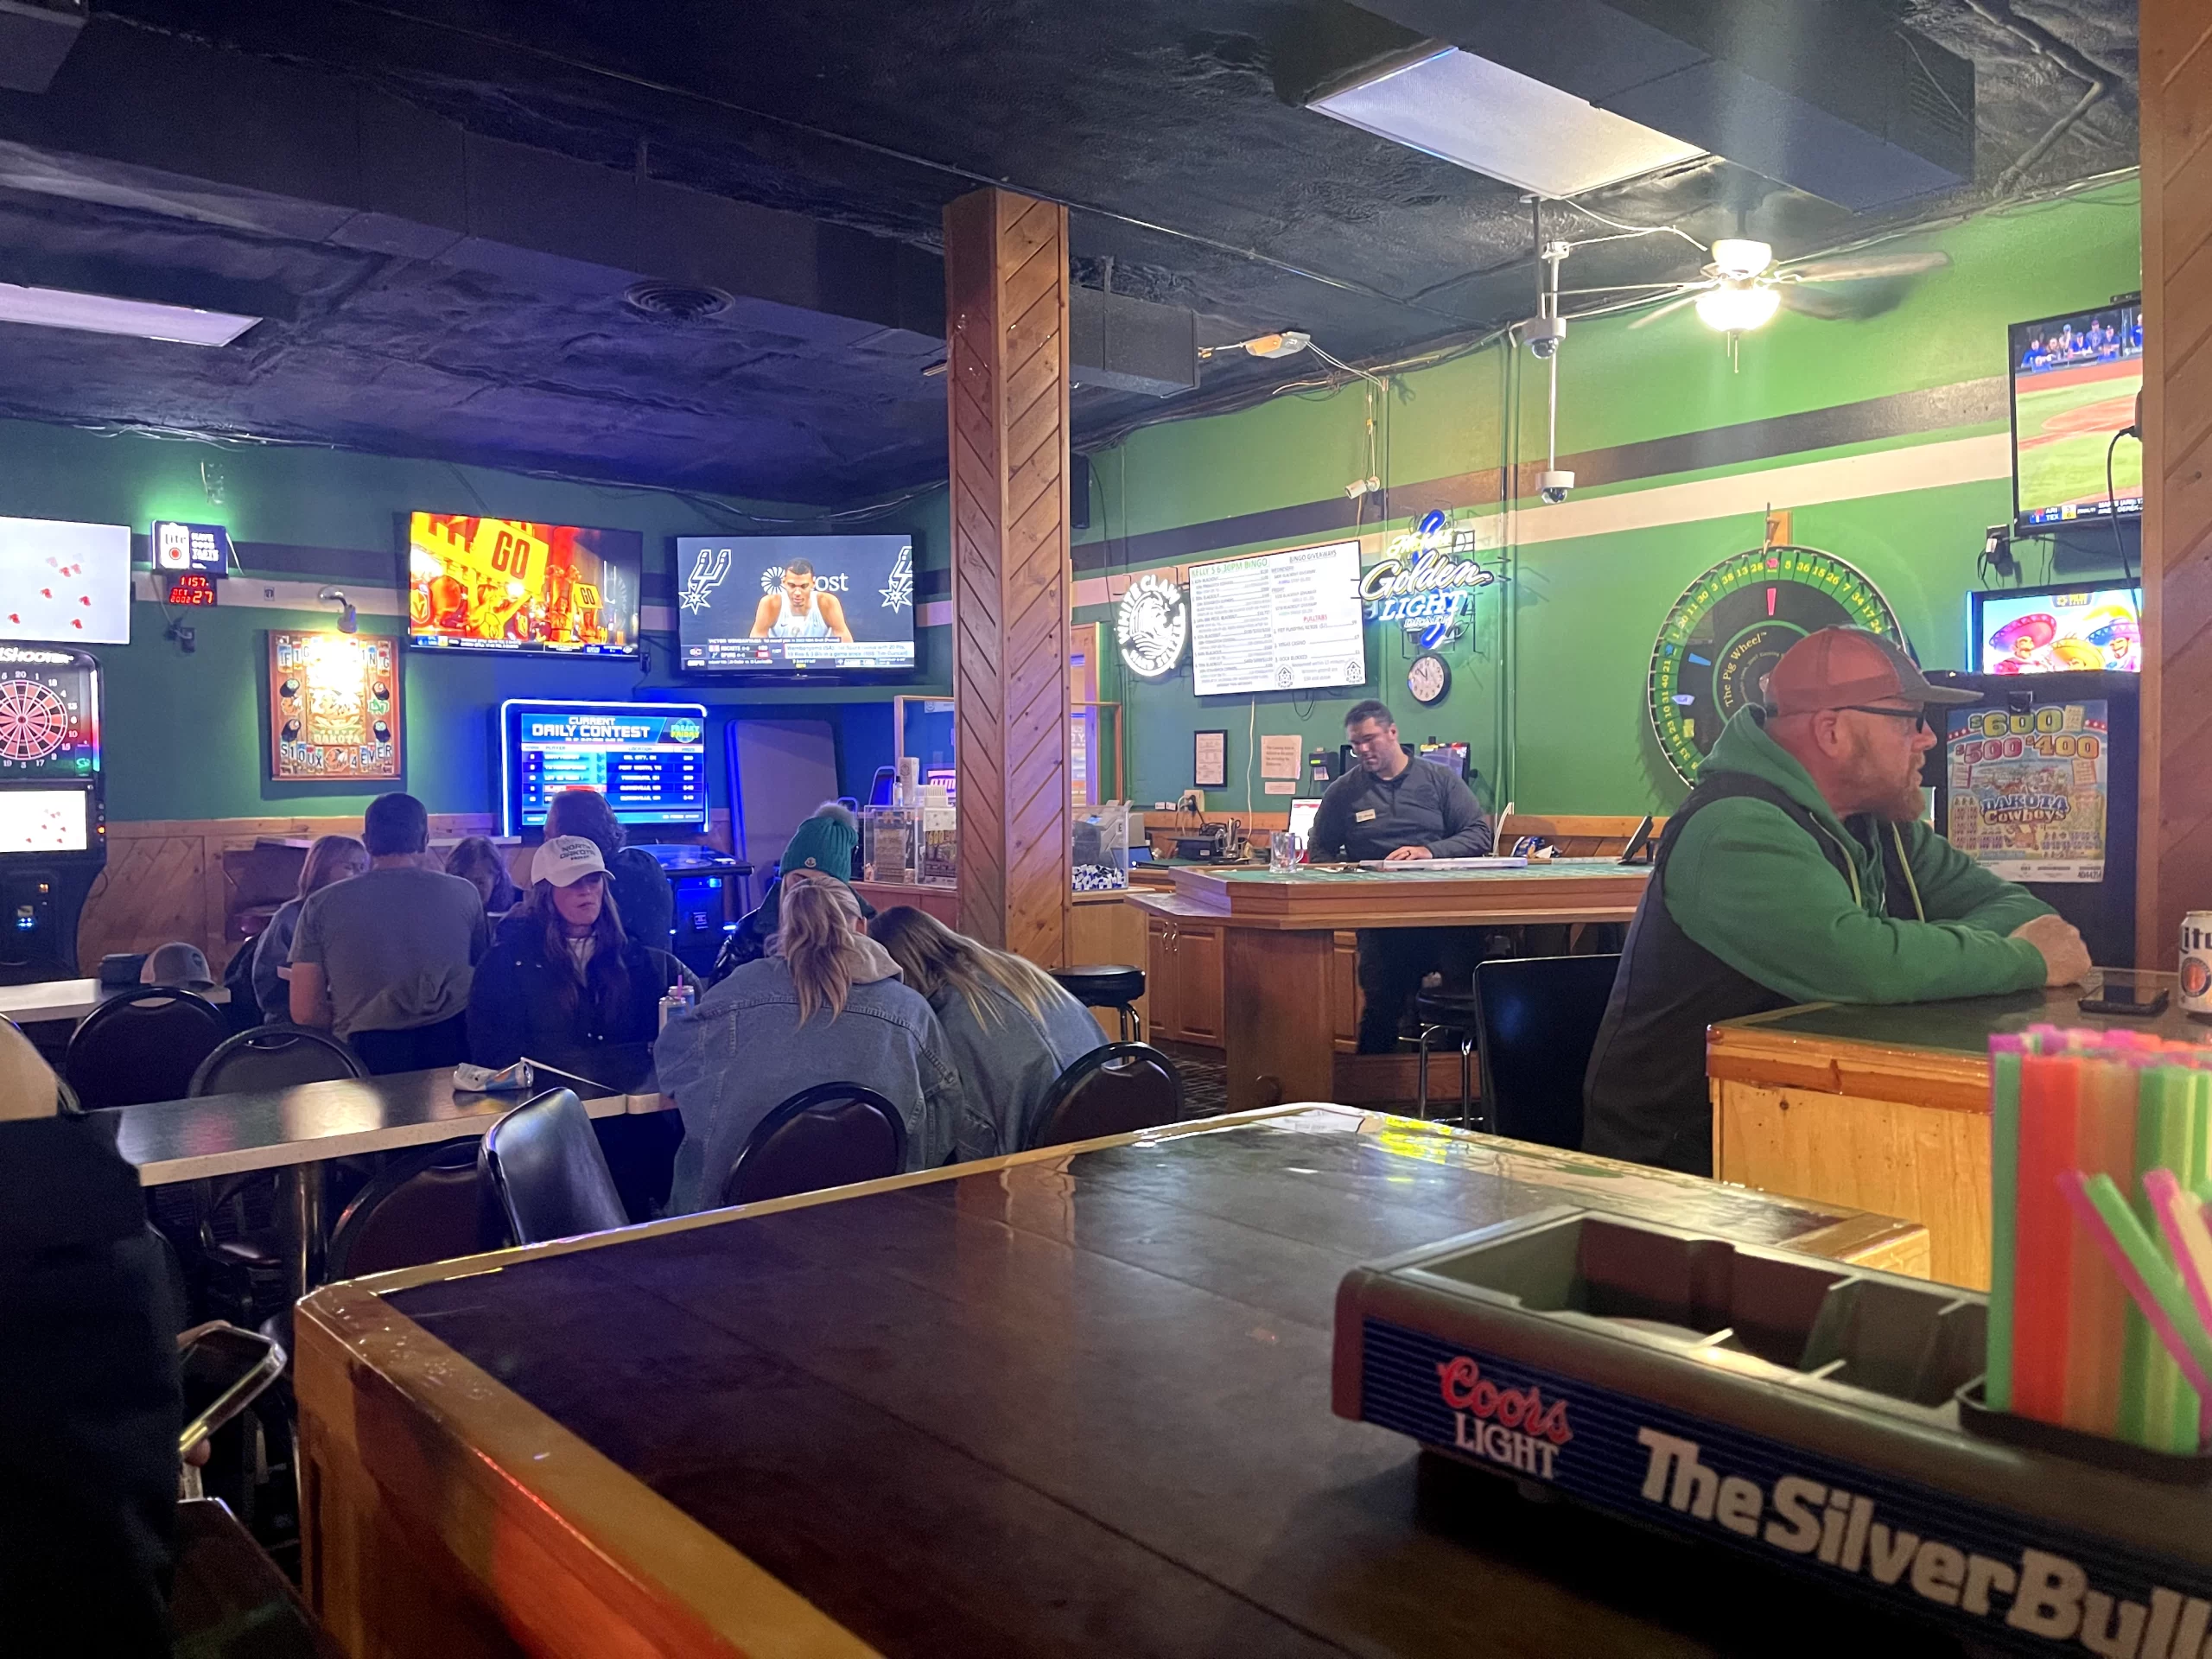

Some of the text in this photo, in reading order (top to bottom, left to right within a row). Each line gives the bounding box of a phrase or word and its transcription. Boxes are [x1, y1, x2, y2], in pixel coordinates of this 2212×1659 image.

[491, 530, 531, 580] GO
[1192, 557, 1268, 577] KELLYS 630PM BINGO
[1736, 566, 1749, 577] 13
[1784, 560, 1791, 569] 5
[1796, 562, 1810, 573] 36
[1359, 549, 1494, 601] Golden
[1721, 573, 1734, 584] 38
[1812, 566, 1826, 578] 15
[1826, 573, 1840, 585] 26
[813, 572, 849, 592] ost
[1842, 582, 1851, 592] 7
[192, 590, 213, 604] 27
[580, 587, 596, 606] GO
[1697, 590, 1709, 603] 30
[1852, 591, 1865, 606] 34
[1117, 574, 1180, 645] WHITE CLAW
[1379, 590, 1468, 621] LIGHT
[1687, 603, 1698, 615] 11
[1862, 605, 1875, 619] 17
[1662, 660, 1671, 672] 21
[1723, 662, 1737, 680] Pig
[1662, 691, 1669, 703] 31
[1723, 684, 1733, 707] The
[1663, 706, 1672, 718] 10
[568, 716, 615, 726] CURRENT
[1668, 720, 1676, 734] 23
[1968, 706, 2064, 738] $600
[531, 723, 650, 738] DAILY CONTEST
[313, 734, 361, 745] DAKOTA
[1955, 736, 2024, 765] $500
[2024, 734, 2100, 760] $400
[1980, 794, 2070, 814] DAKOTA
[1983, 808, 2067, 825] Cowboys
[560, 849, 596, 859] DAKOTA
[563, 843, 591, 852] NORTH
[1436, 1356, 1573, 1445] Coors
[1454, 1412, 1559, 1479] LIGHT
[2005, 1548, 2212, 1659] Bull
